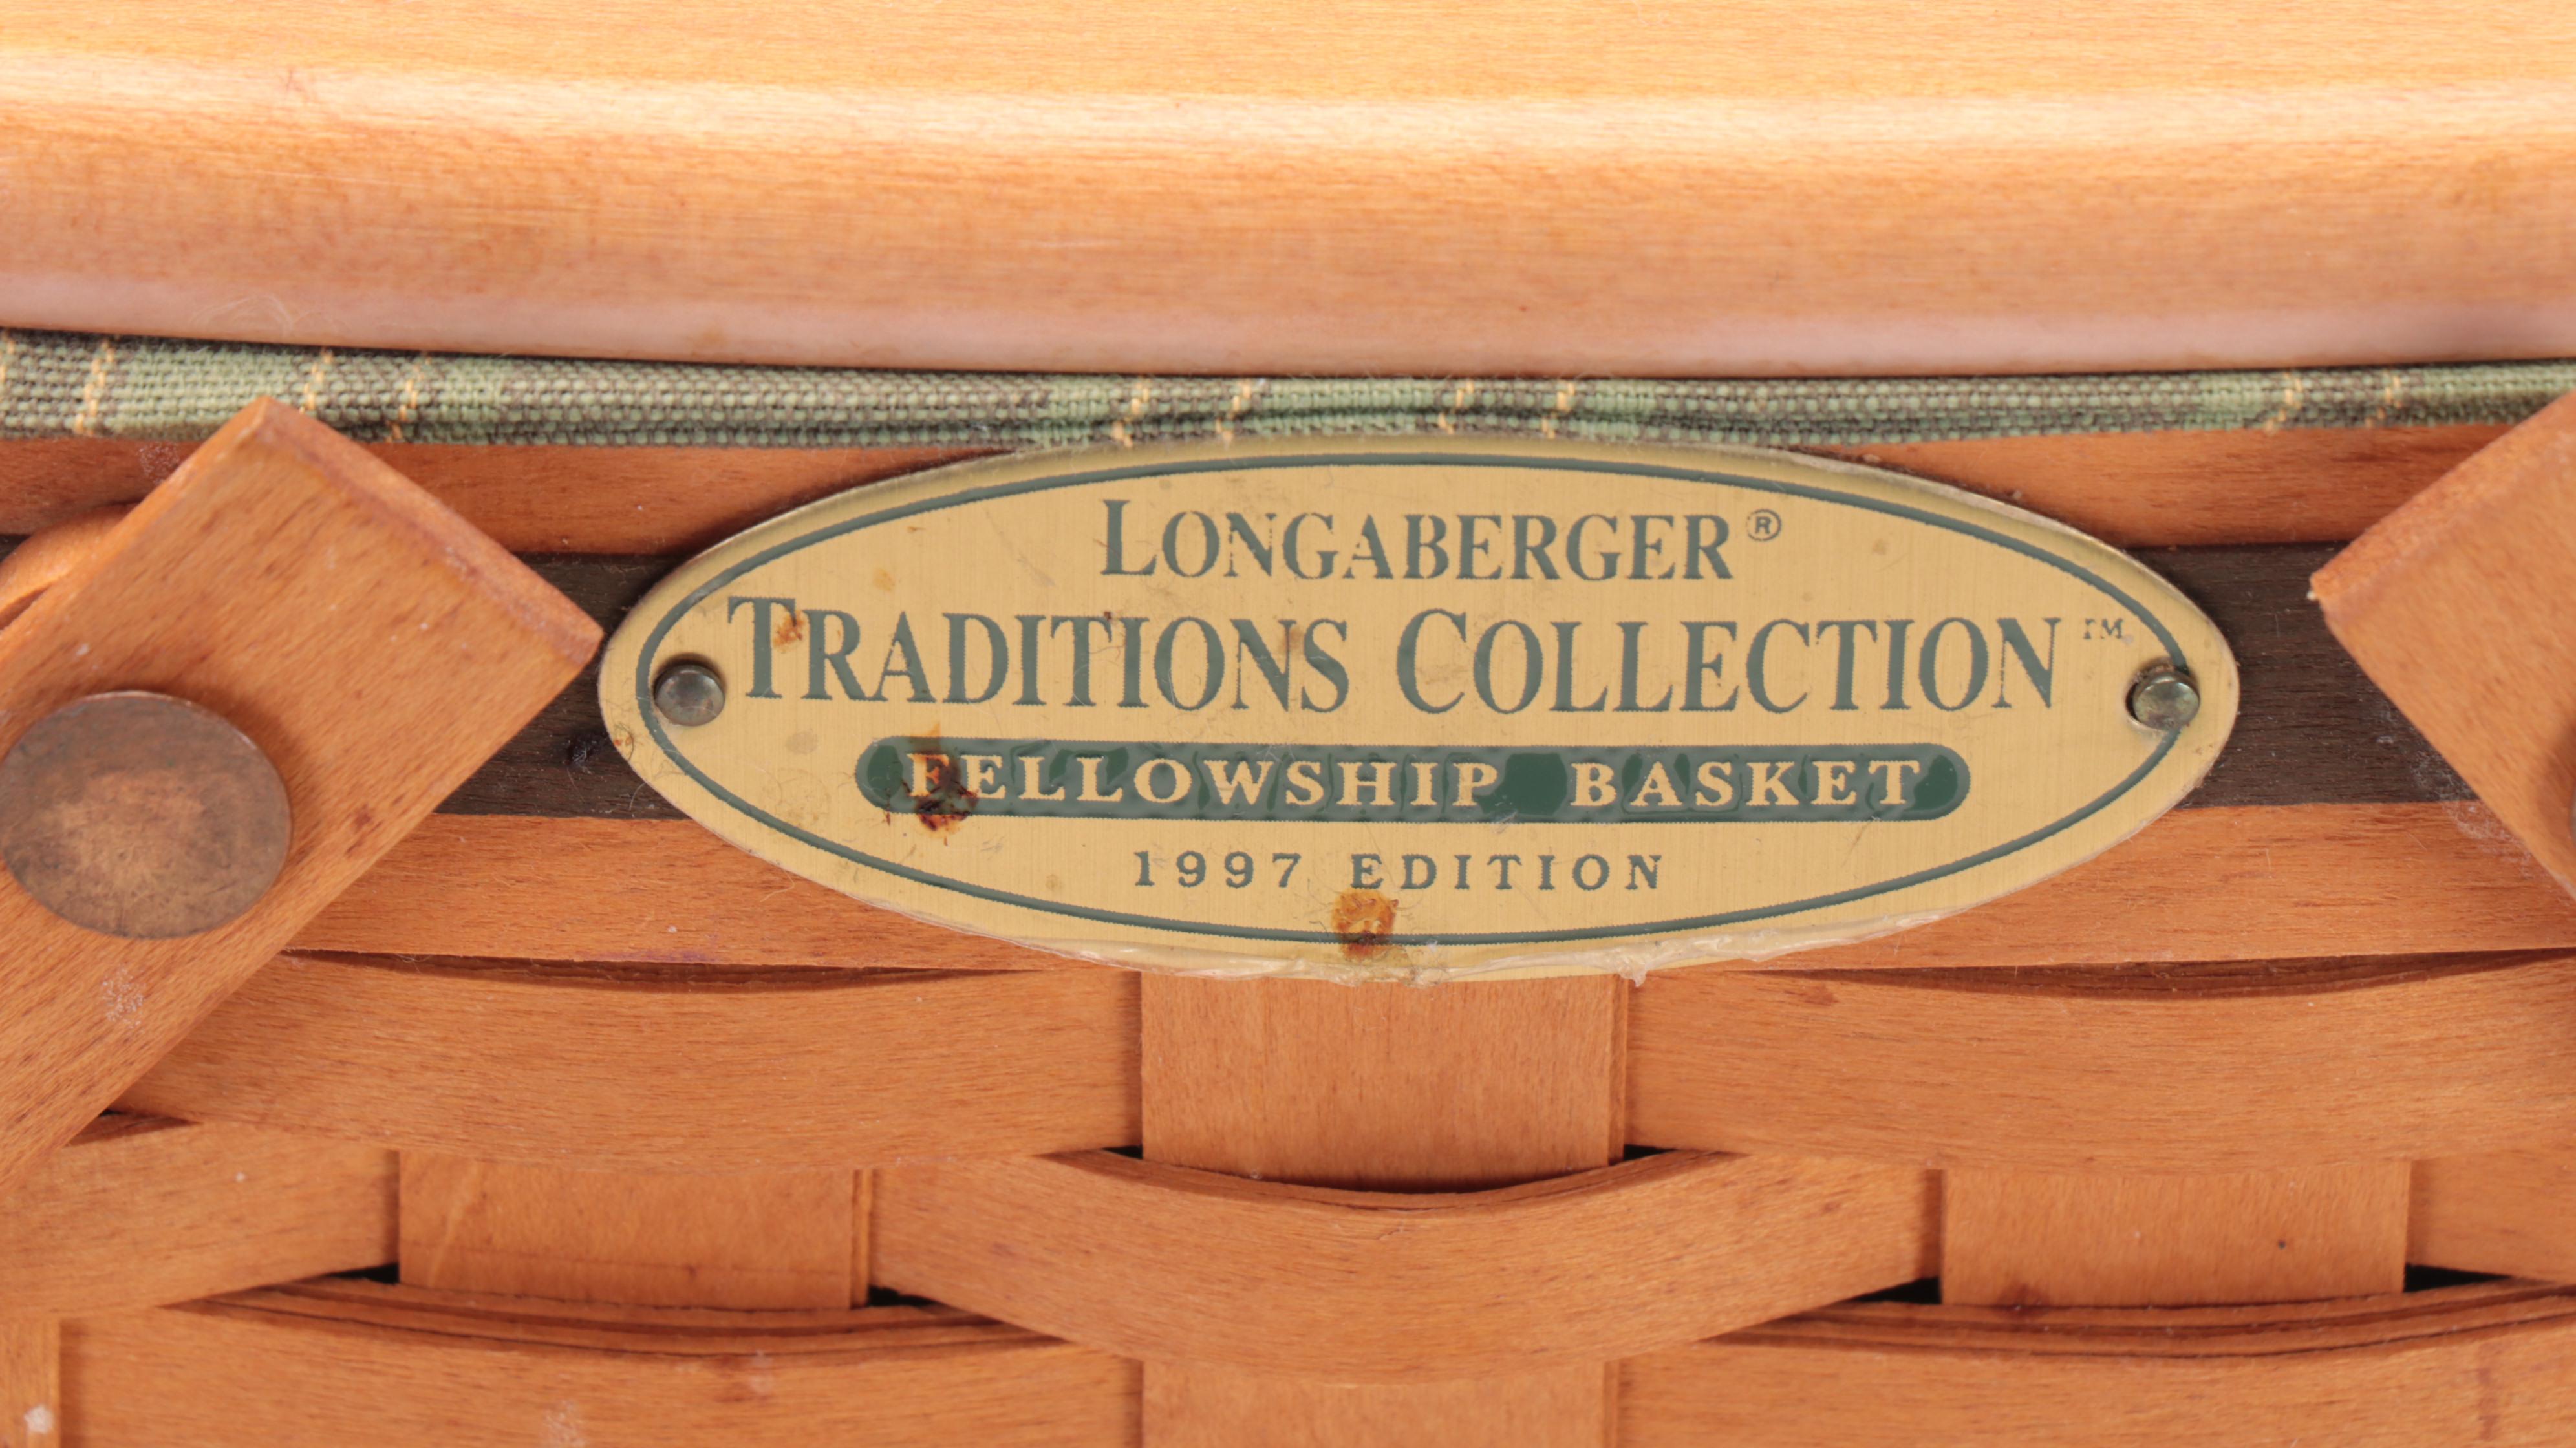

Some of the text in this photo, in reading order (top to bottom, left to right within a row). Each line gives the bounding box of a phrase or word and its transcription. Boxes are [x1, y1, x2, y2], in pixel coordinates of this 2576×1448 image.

[727, 596, 1349, 713] TRADITIONS
[1396, 609, 2061, 714] COLLECTION
[907, 752, 1922, 809] FELLOWSHIP BASKET
[1135, 851, 1662, 891] 1997 EDITION
